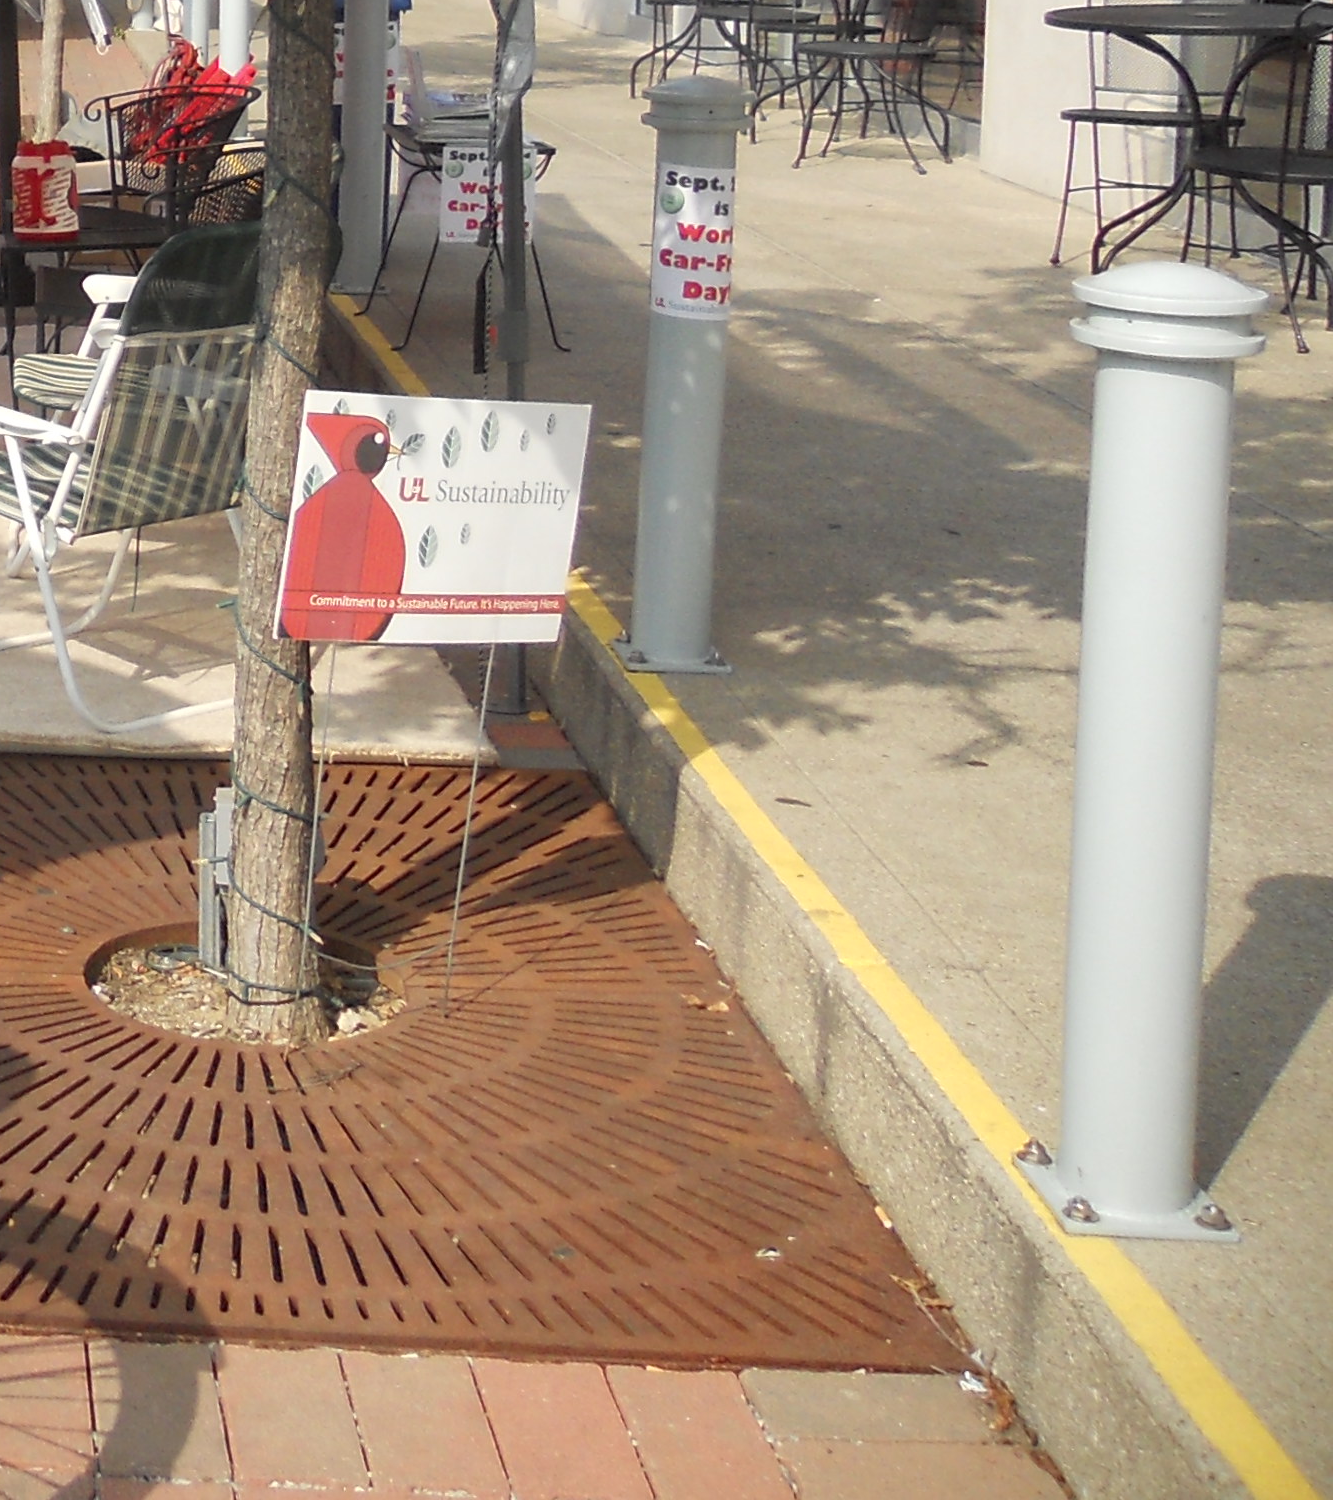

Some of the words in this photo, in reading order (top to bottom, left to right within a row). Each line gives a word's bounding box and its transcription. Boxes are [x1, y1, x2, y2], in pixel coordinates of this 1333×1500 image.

[665, 171, 726, 193] Sept.
[715, 201, 729, 217] is
[435, 479, 570, 511] Sustainability
[309, 594, 376, 608] Commitment
[377, 598, 388, 609] to
[389, 600, 396, 609] a
[396, 597, 449, 609] Sustainable
[449, 598, 479, 610] Future.
[480, 599, 492, 610] It's
[493, 600, 539, 612] Happening
[539, 599, 560, 609] Here.
